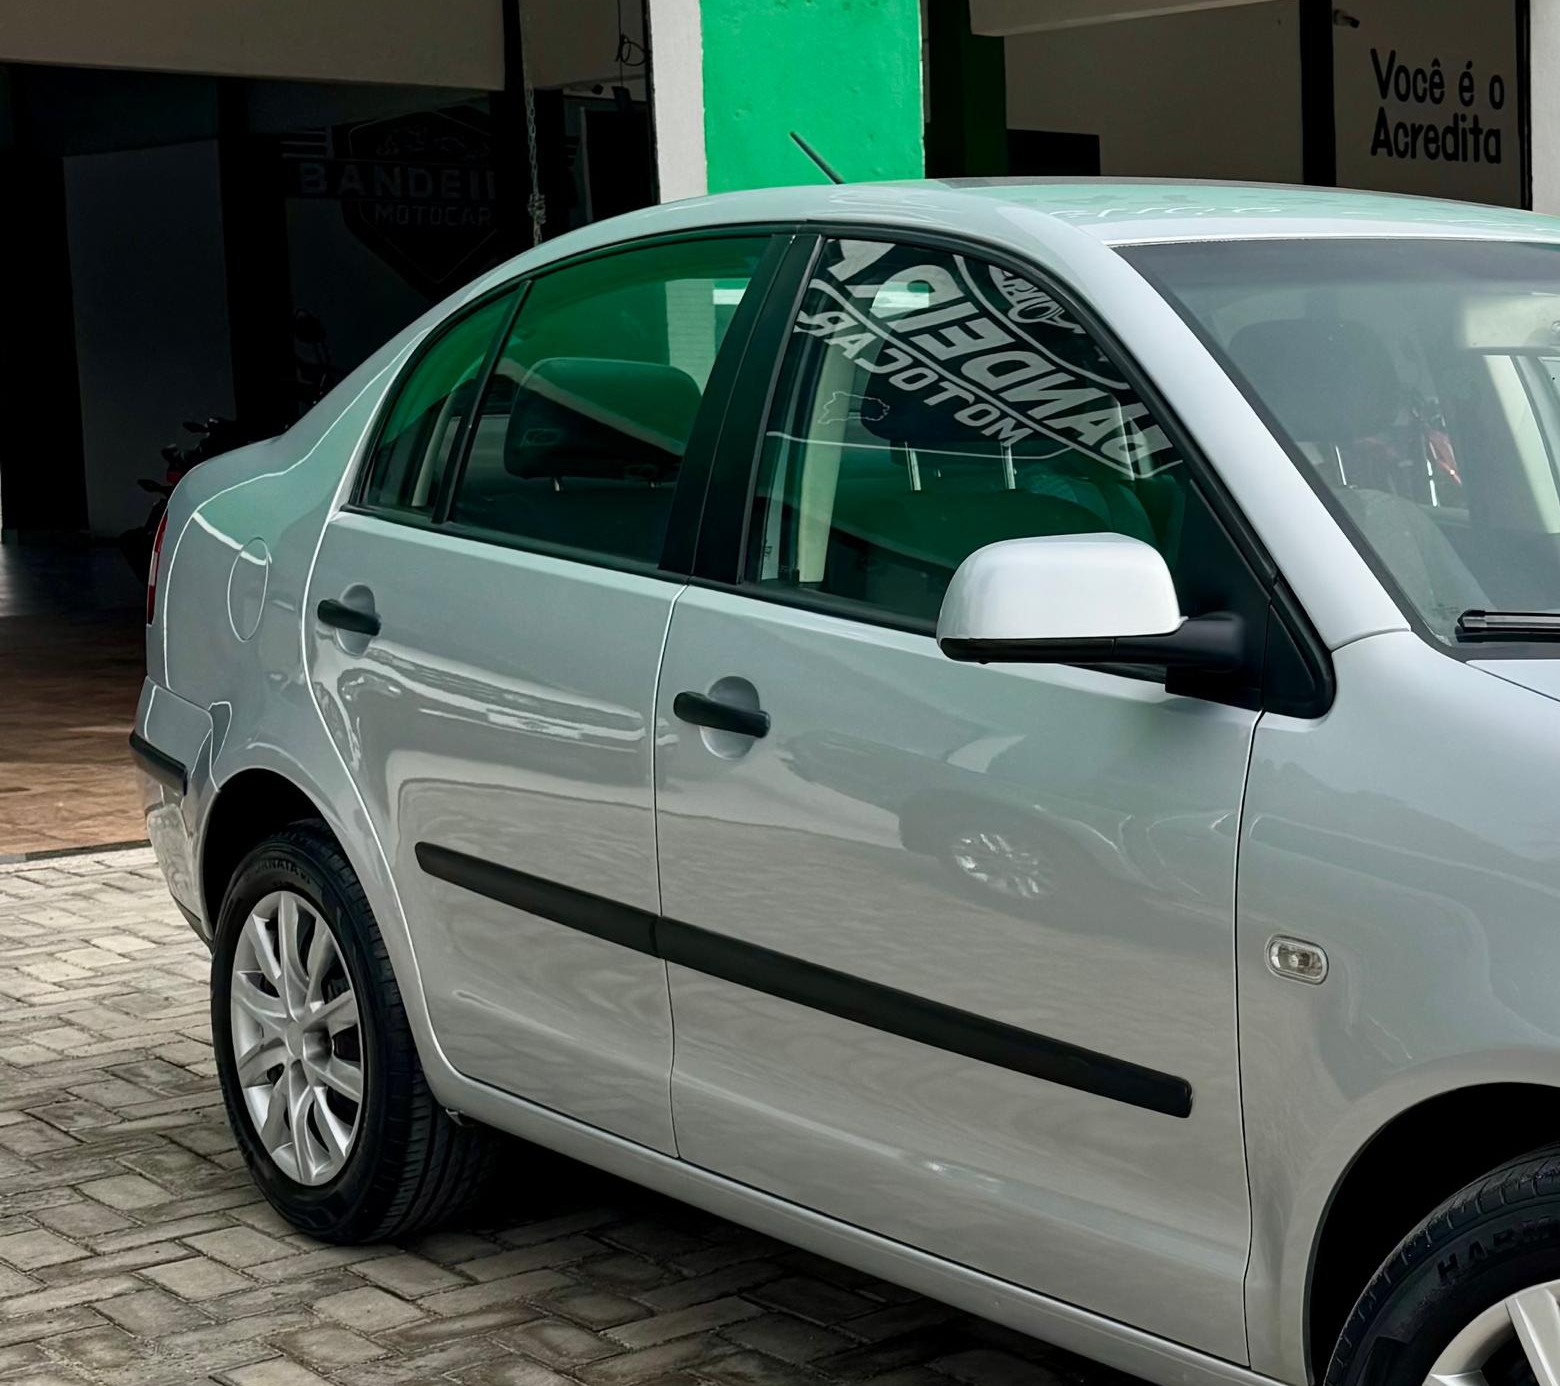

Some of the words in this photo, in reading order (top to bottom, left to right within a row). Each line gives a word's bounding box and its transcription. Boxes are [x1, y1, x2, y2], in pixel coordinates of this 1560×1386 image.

[1370, 48, 1446, 105] Você
[1458, 60, 1474, 106] é
[1489, 75, 1506, 111] o
[1370, 105, 1502, 165] Acredita
